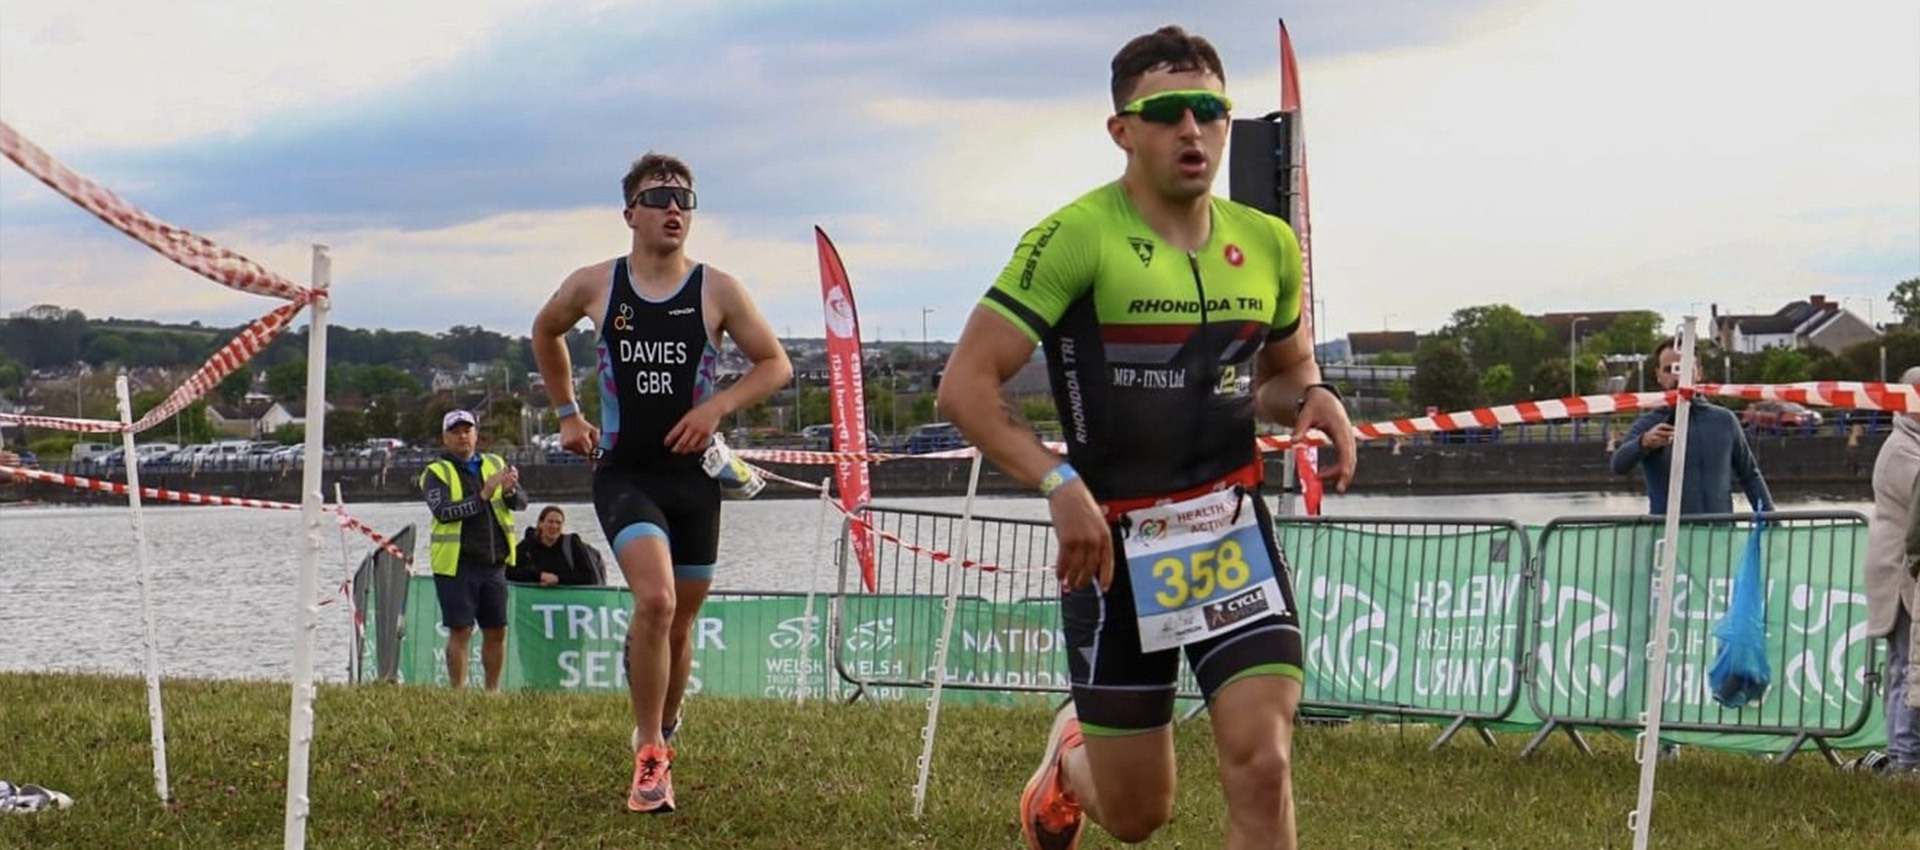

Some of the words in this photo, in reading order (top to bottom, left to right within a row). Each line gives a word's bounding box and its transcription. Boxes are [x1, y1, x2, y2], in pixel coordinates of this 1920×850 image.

[1128, 299, 1231, 313] RHONDDA
[1237, 298, 1263, 311] TRI
[620, 339, 687, 364] DAVIES
[1061, 337, 1076, 363] TRI
[636, 371, 673, 394] GBR
[1169, 368, 1186, 388] Ltd
[1065, 370, 1087, 445] RHONDDA
[1177, 503, 1226, 522] HEALTH
[1152, 540, 1250, 608] 358
[1227, 590, 1264, 612] CYCLE
